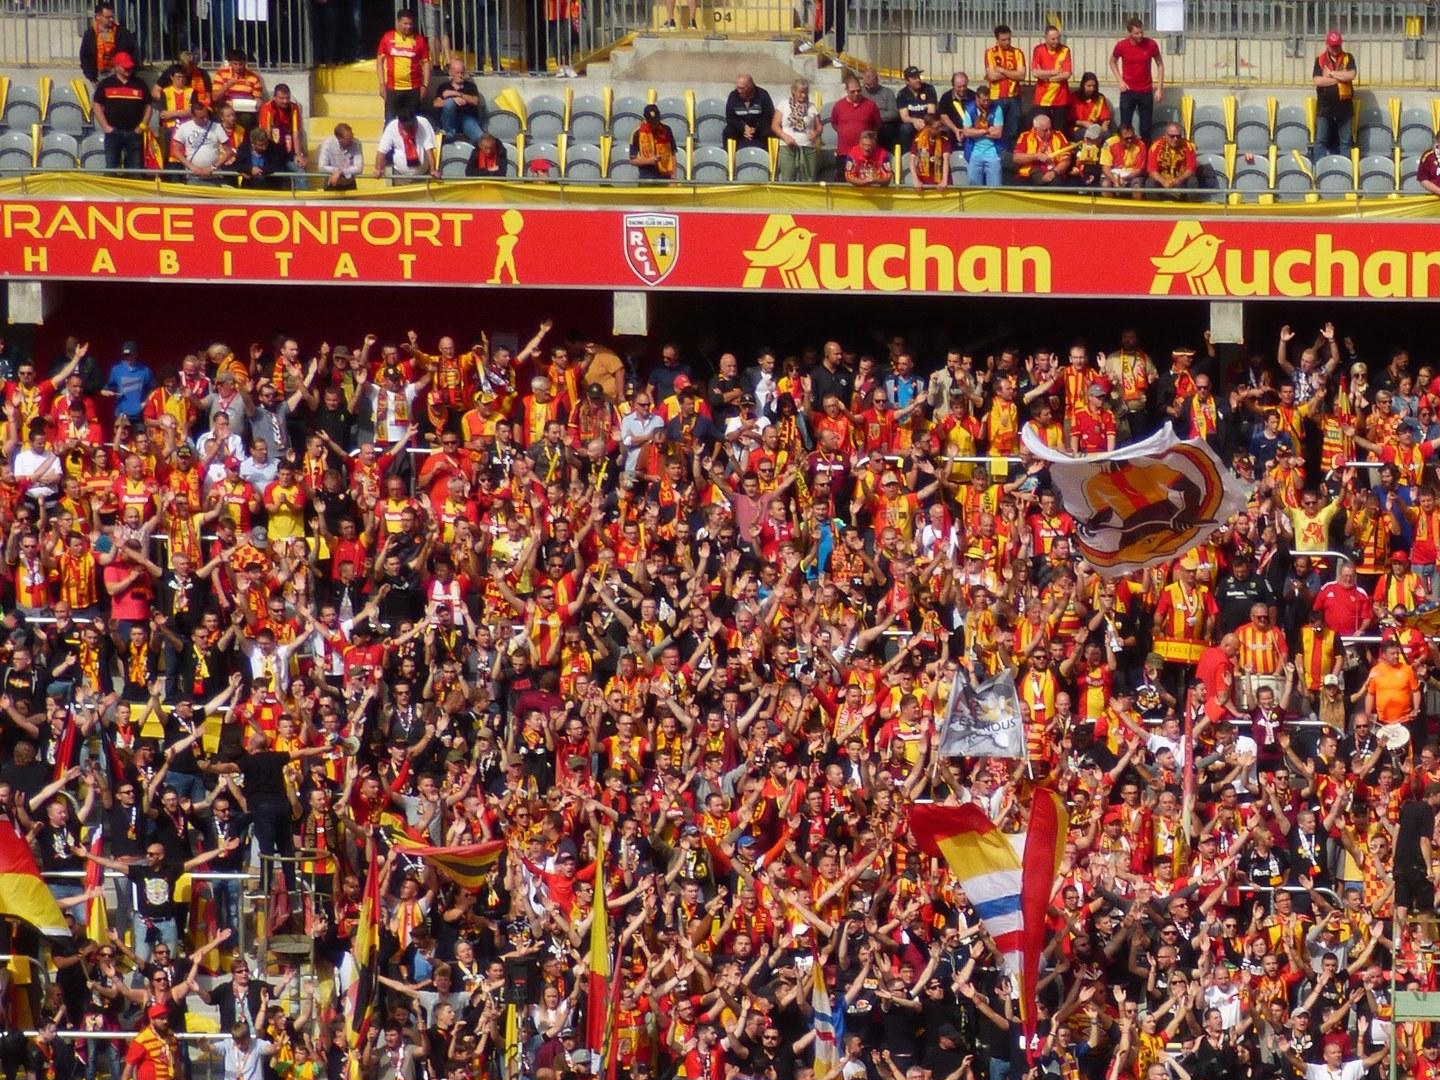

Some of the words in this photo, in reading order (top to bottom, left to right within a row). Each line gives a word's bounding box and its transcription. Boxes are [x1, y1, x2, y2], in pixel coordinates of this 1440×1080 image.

[0, 204, 195, 241] RANCE
[212, 208, 474, 248] CONFORT
[23, 246, 417, 280] HABITAT
[742, 214, 1052, 294] Auchan
